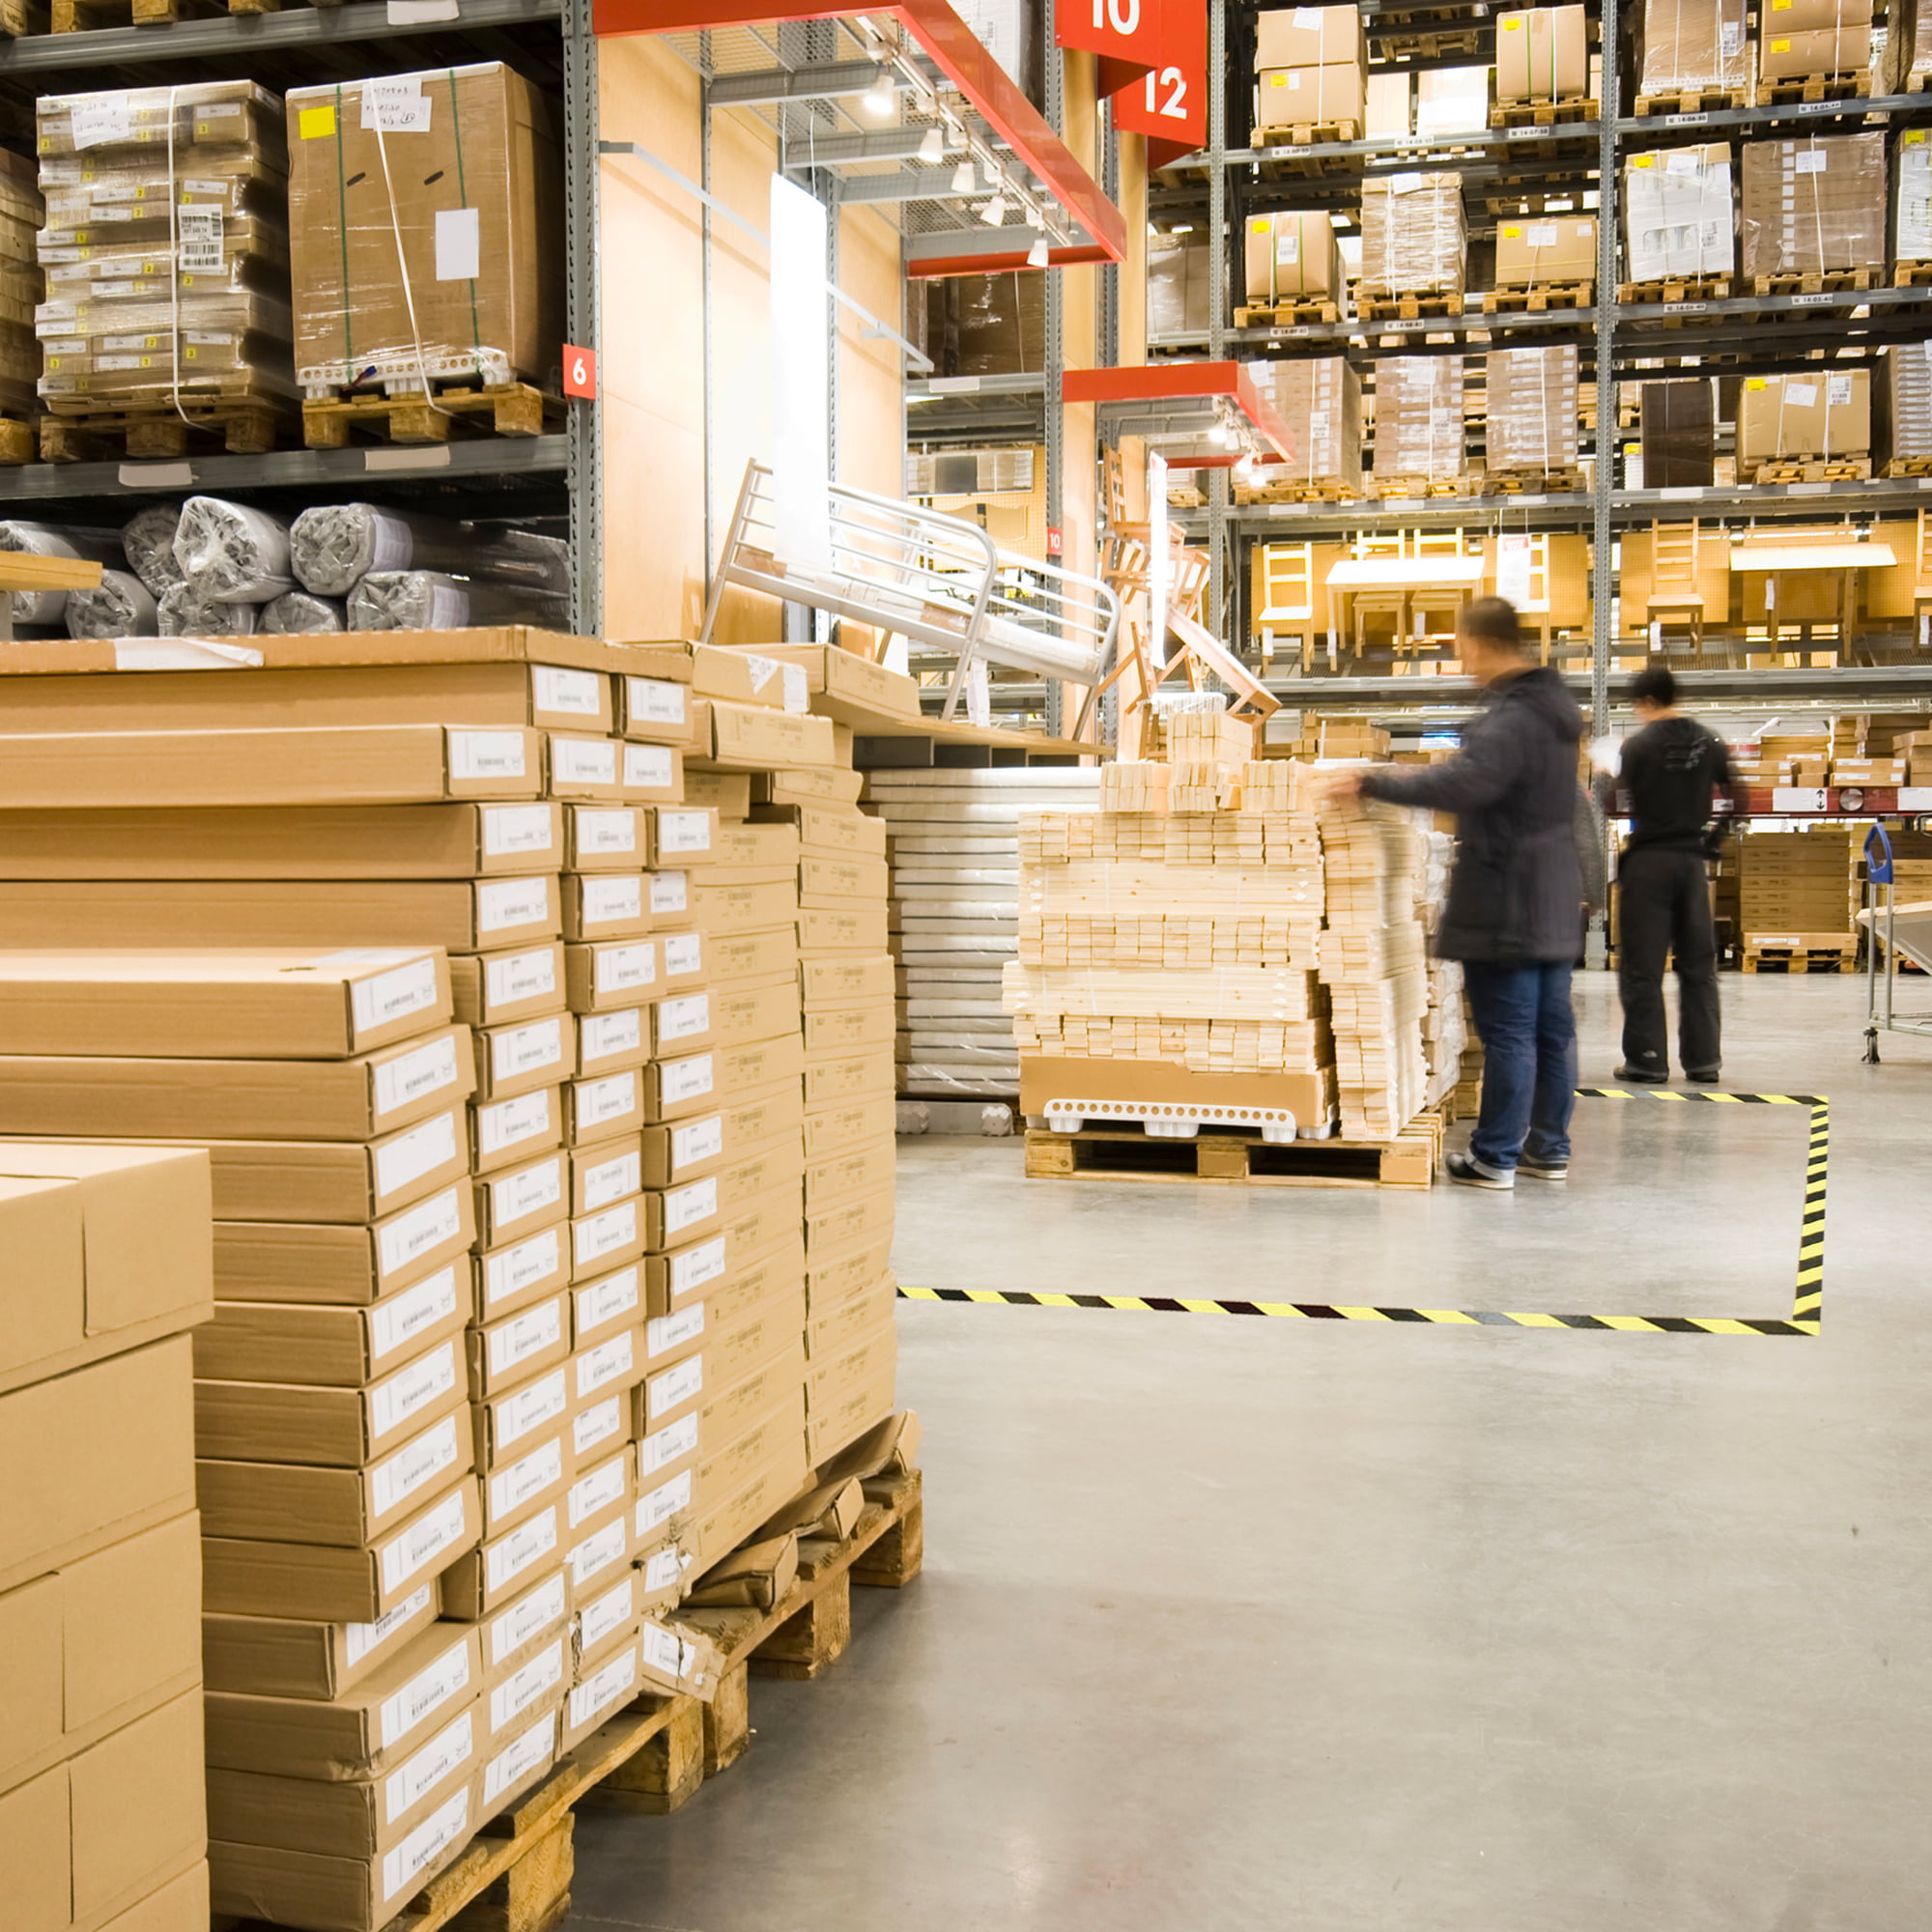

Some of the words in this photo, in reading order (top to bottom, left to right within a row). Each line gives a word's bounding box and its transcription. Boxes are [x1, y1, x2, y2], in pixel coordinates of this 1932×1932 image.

[1093, 0, 1141, 36] 10
[1145, 67, 1187, 120] 12
[573, 357, 586, 385] 6
[1049, 533, 1060, 549] 10
